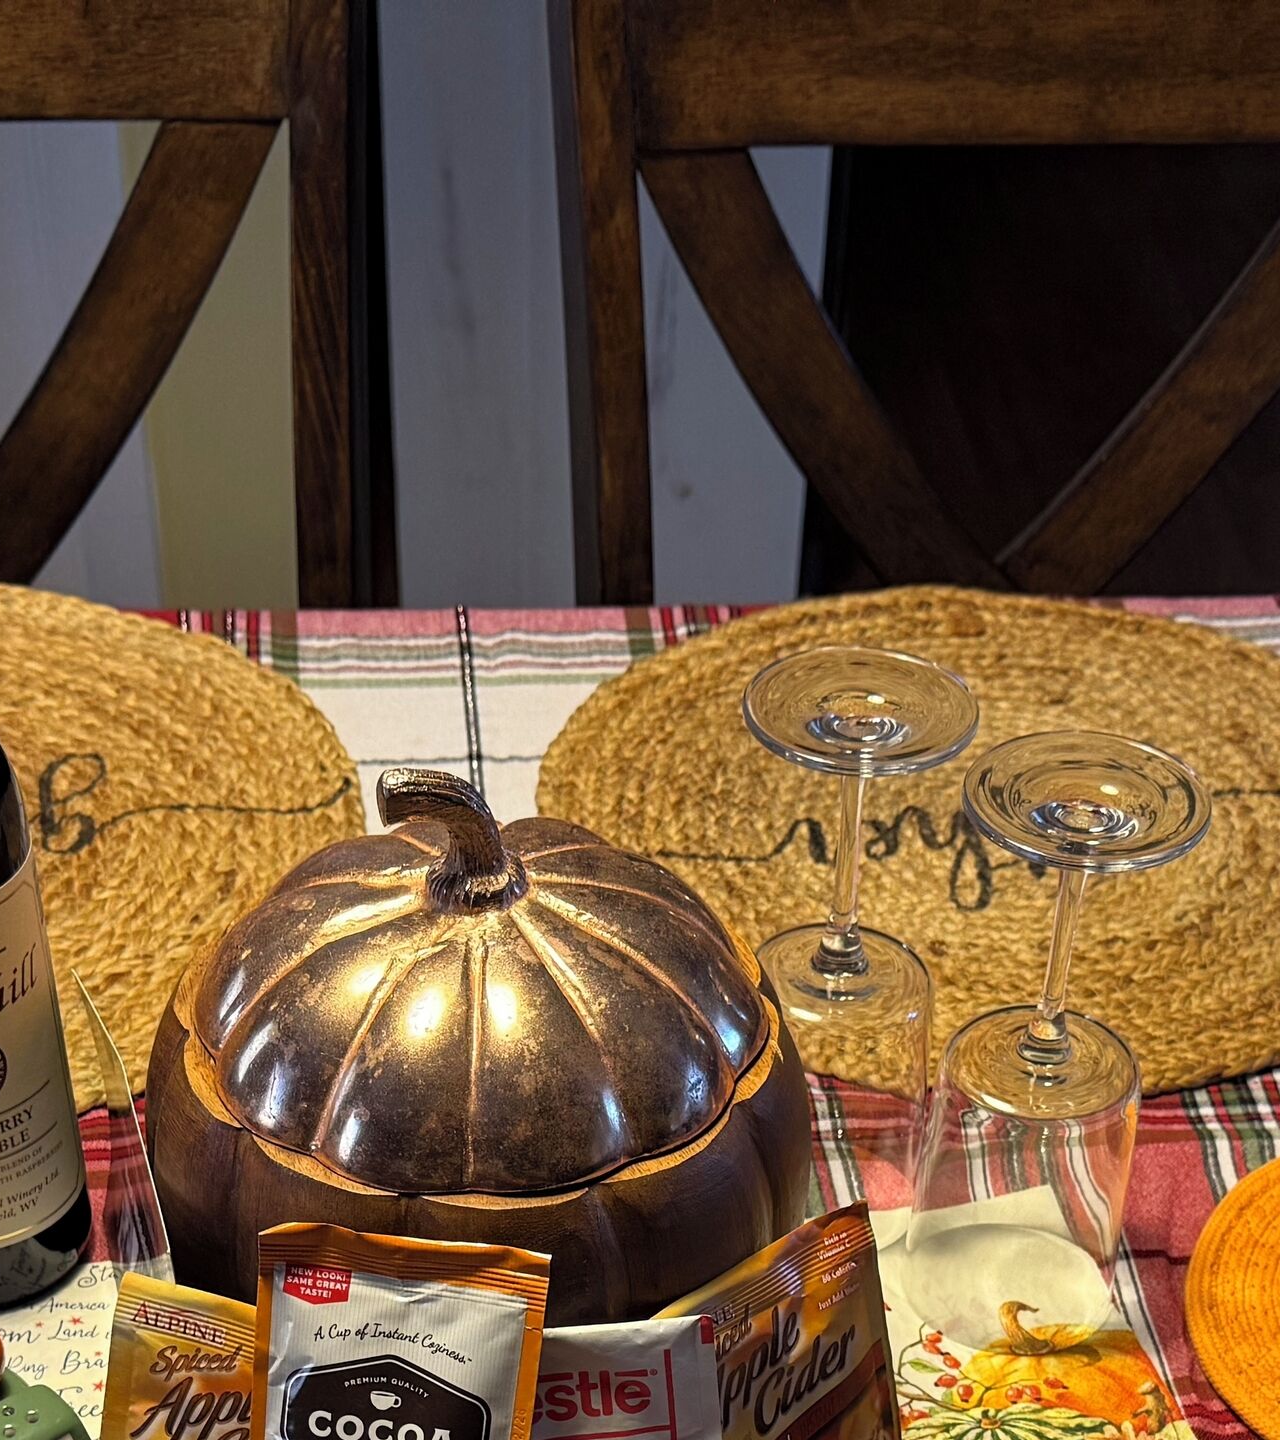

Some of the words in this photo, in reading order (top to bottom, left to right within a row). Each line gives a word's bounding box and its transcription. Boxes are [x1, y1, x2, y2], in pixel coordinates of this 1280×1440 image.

[0, 1154, 31, 1173] BLEND
[6, 1180, 44, 1205] Winery
[19, 1195, 39, 1213] WV
[286, 1275, 313, 1286] SAME
[316, 1279, 348, 1291] GREAT
[290, 1266, 313, 1276] NEW
[316, 1270, 346, 1281] LOOK!
[300, 1286, 332, 1299] TASTE!
[37, 1297, 110, 1314] America
[48, 1319, 100, 1342] Land
[131, 1300, 228, 1348] ALPINE
[314, 1325, 325, 1343] A
[328, 1323, 351, 1340] Cup
[355, 1322, 369, 1339] of
[370, 1322, 421, 1344] Instant
[149, 1343, 243, 1382] Spiced
[344, 1376, 387, 1389] PREMIUM
[391, 1378, 430, 1399] QUALITY
[754, 1324, 856, 1436] Cider
